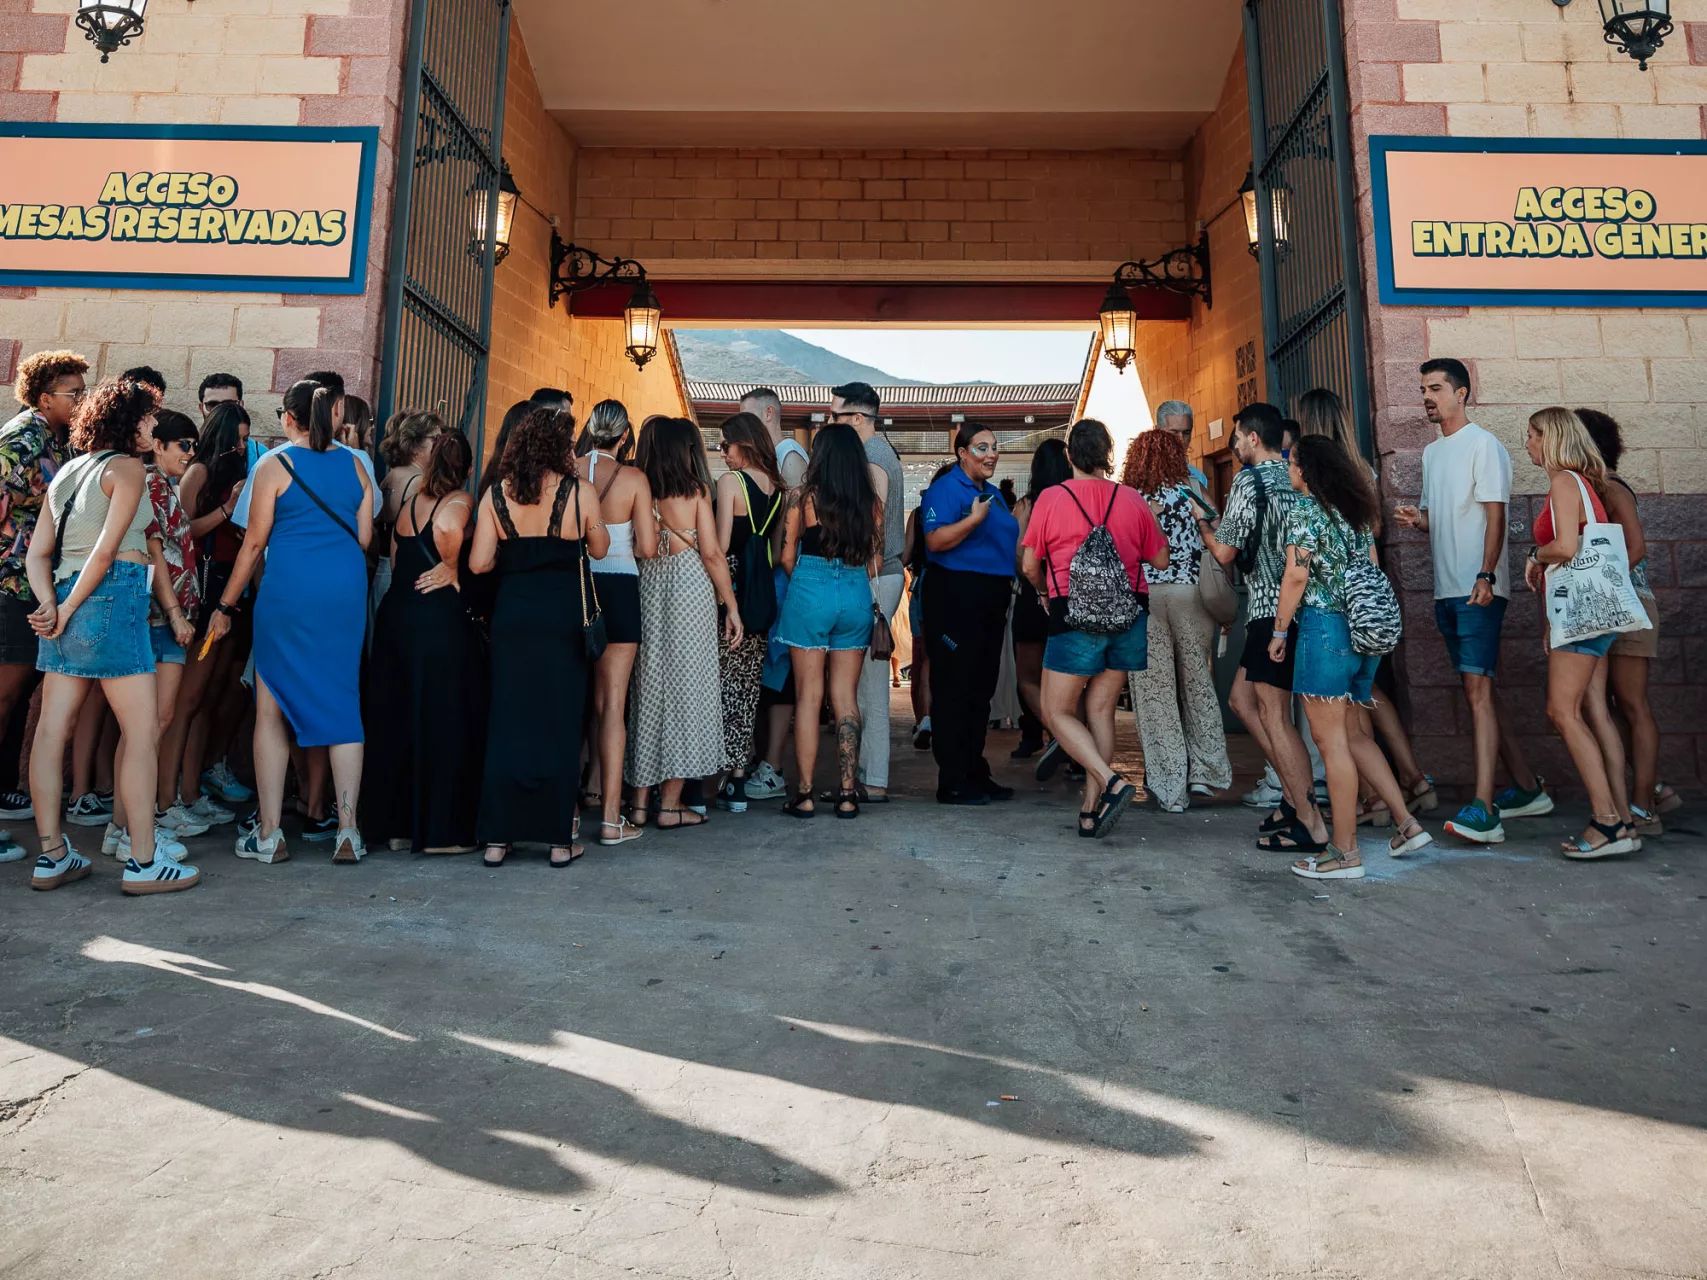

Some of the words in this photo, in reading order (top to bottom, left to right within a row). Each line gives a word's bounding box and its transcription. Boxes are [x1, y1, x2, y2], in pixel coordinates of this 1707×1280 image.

[98, 171, 239, 206] ACCESO
[1514, 187, 1657, 221] ACCESO
[0, 204, 110, 241] MESAS
[111, 206, 346, 246] RESERVADAS
[1411, 221, 1594, 258] ENTRADA
[1594, 221, 1707, 259] GENER
